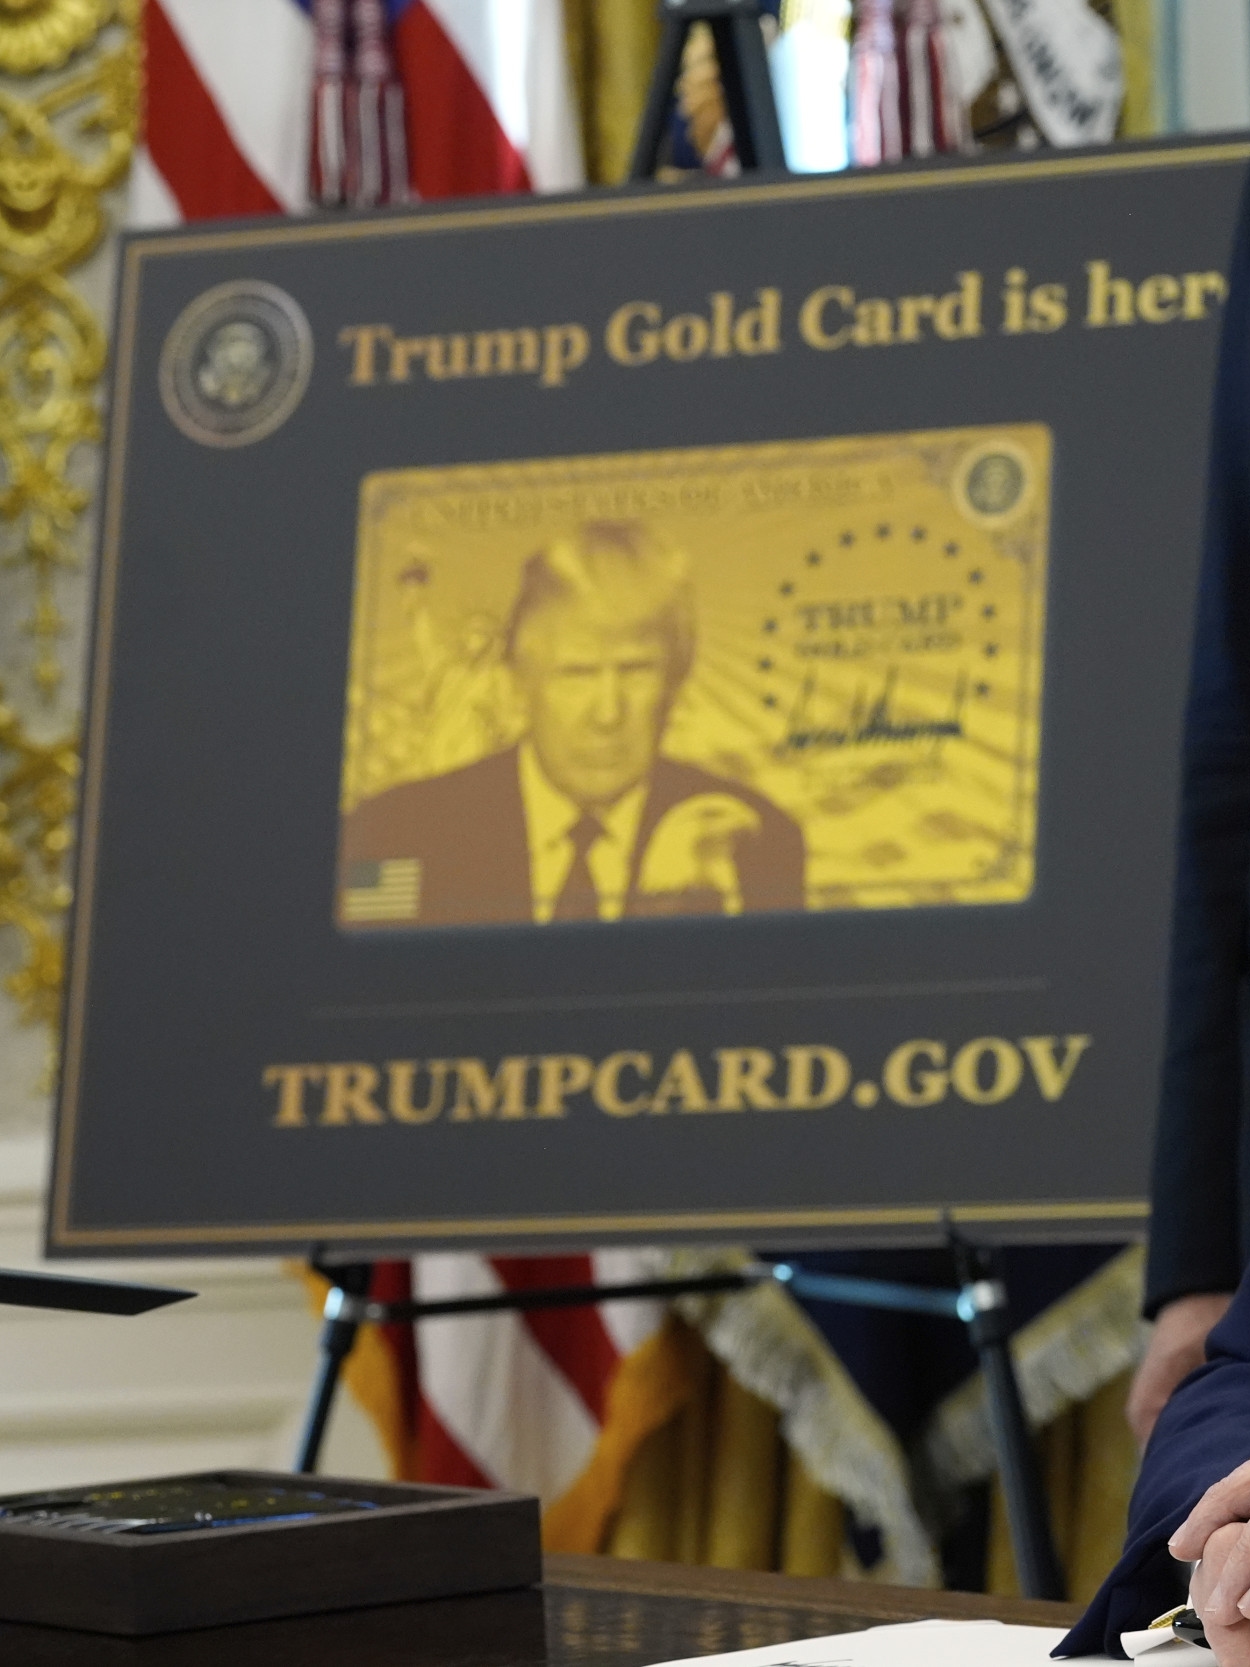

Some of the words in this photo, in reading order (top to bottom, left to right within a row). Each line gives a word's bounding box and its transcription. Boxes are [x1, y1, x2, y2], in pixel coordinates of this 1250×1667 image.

[338, 322, 591, 388] Trump
[605, 291, 783, 368] Gold
[798, 268, 984, 351] Card
[1003, 264, 1070, 336] is
[1085, 258, 1228, 329] her
[263, 1034, 1092, 1128] TRUMPCARD.GOV
